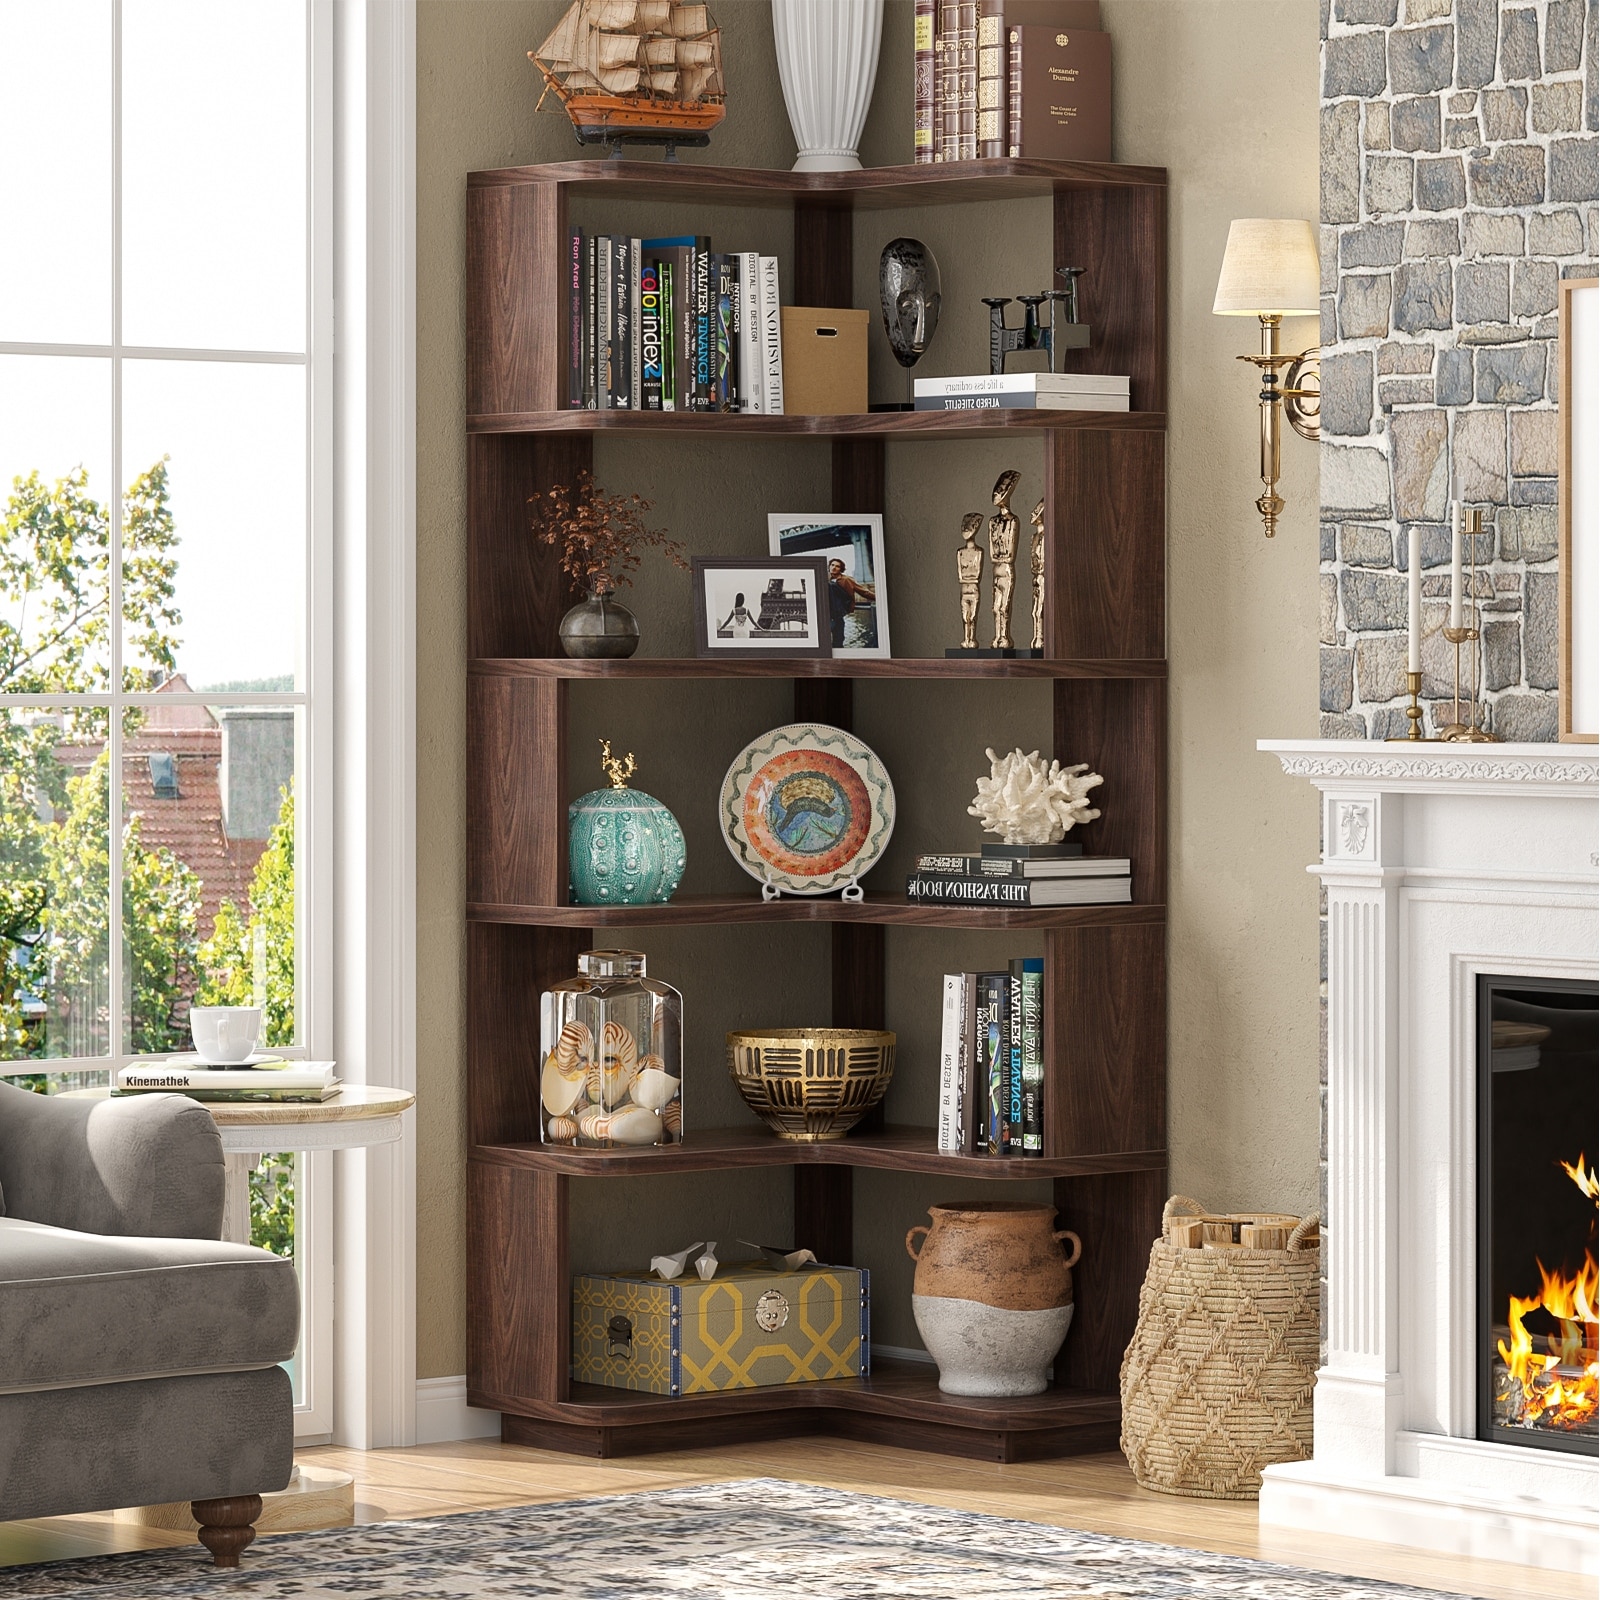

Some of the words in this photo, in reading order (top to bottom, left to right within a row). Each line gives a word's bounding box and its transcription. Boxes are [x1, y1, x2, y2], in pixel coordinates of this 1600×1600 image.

[1048, 66, 1079, 75] Alexandre
[1052, 74, 1075, 82] Dumas
[572, 237, 580, 260] Ron
[572, 263, 580, 289] Arad
[697, 251, 709, 314] WALTER
[764, 259, 776, 305] BOOK
[750, 294, 757, 306] BY
[599, 248, 607, 387] INNENARCHITEKTUR
[750, 310, 758, 343] DESIGN
[697, 316, 709, 384] FINANCE
[766, 309, 779, 377] FASHION
[769, 380, 781, 413] THE
[126, 1076, 190, 1087] Kinemathek
